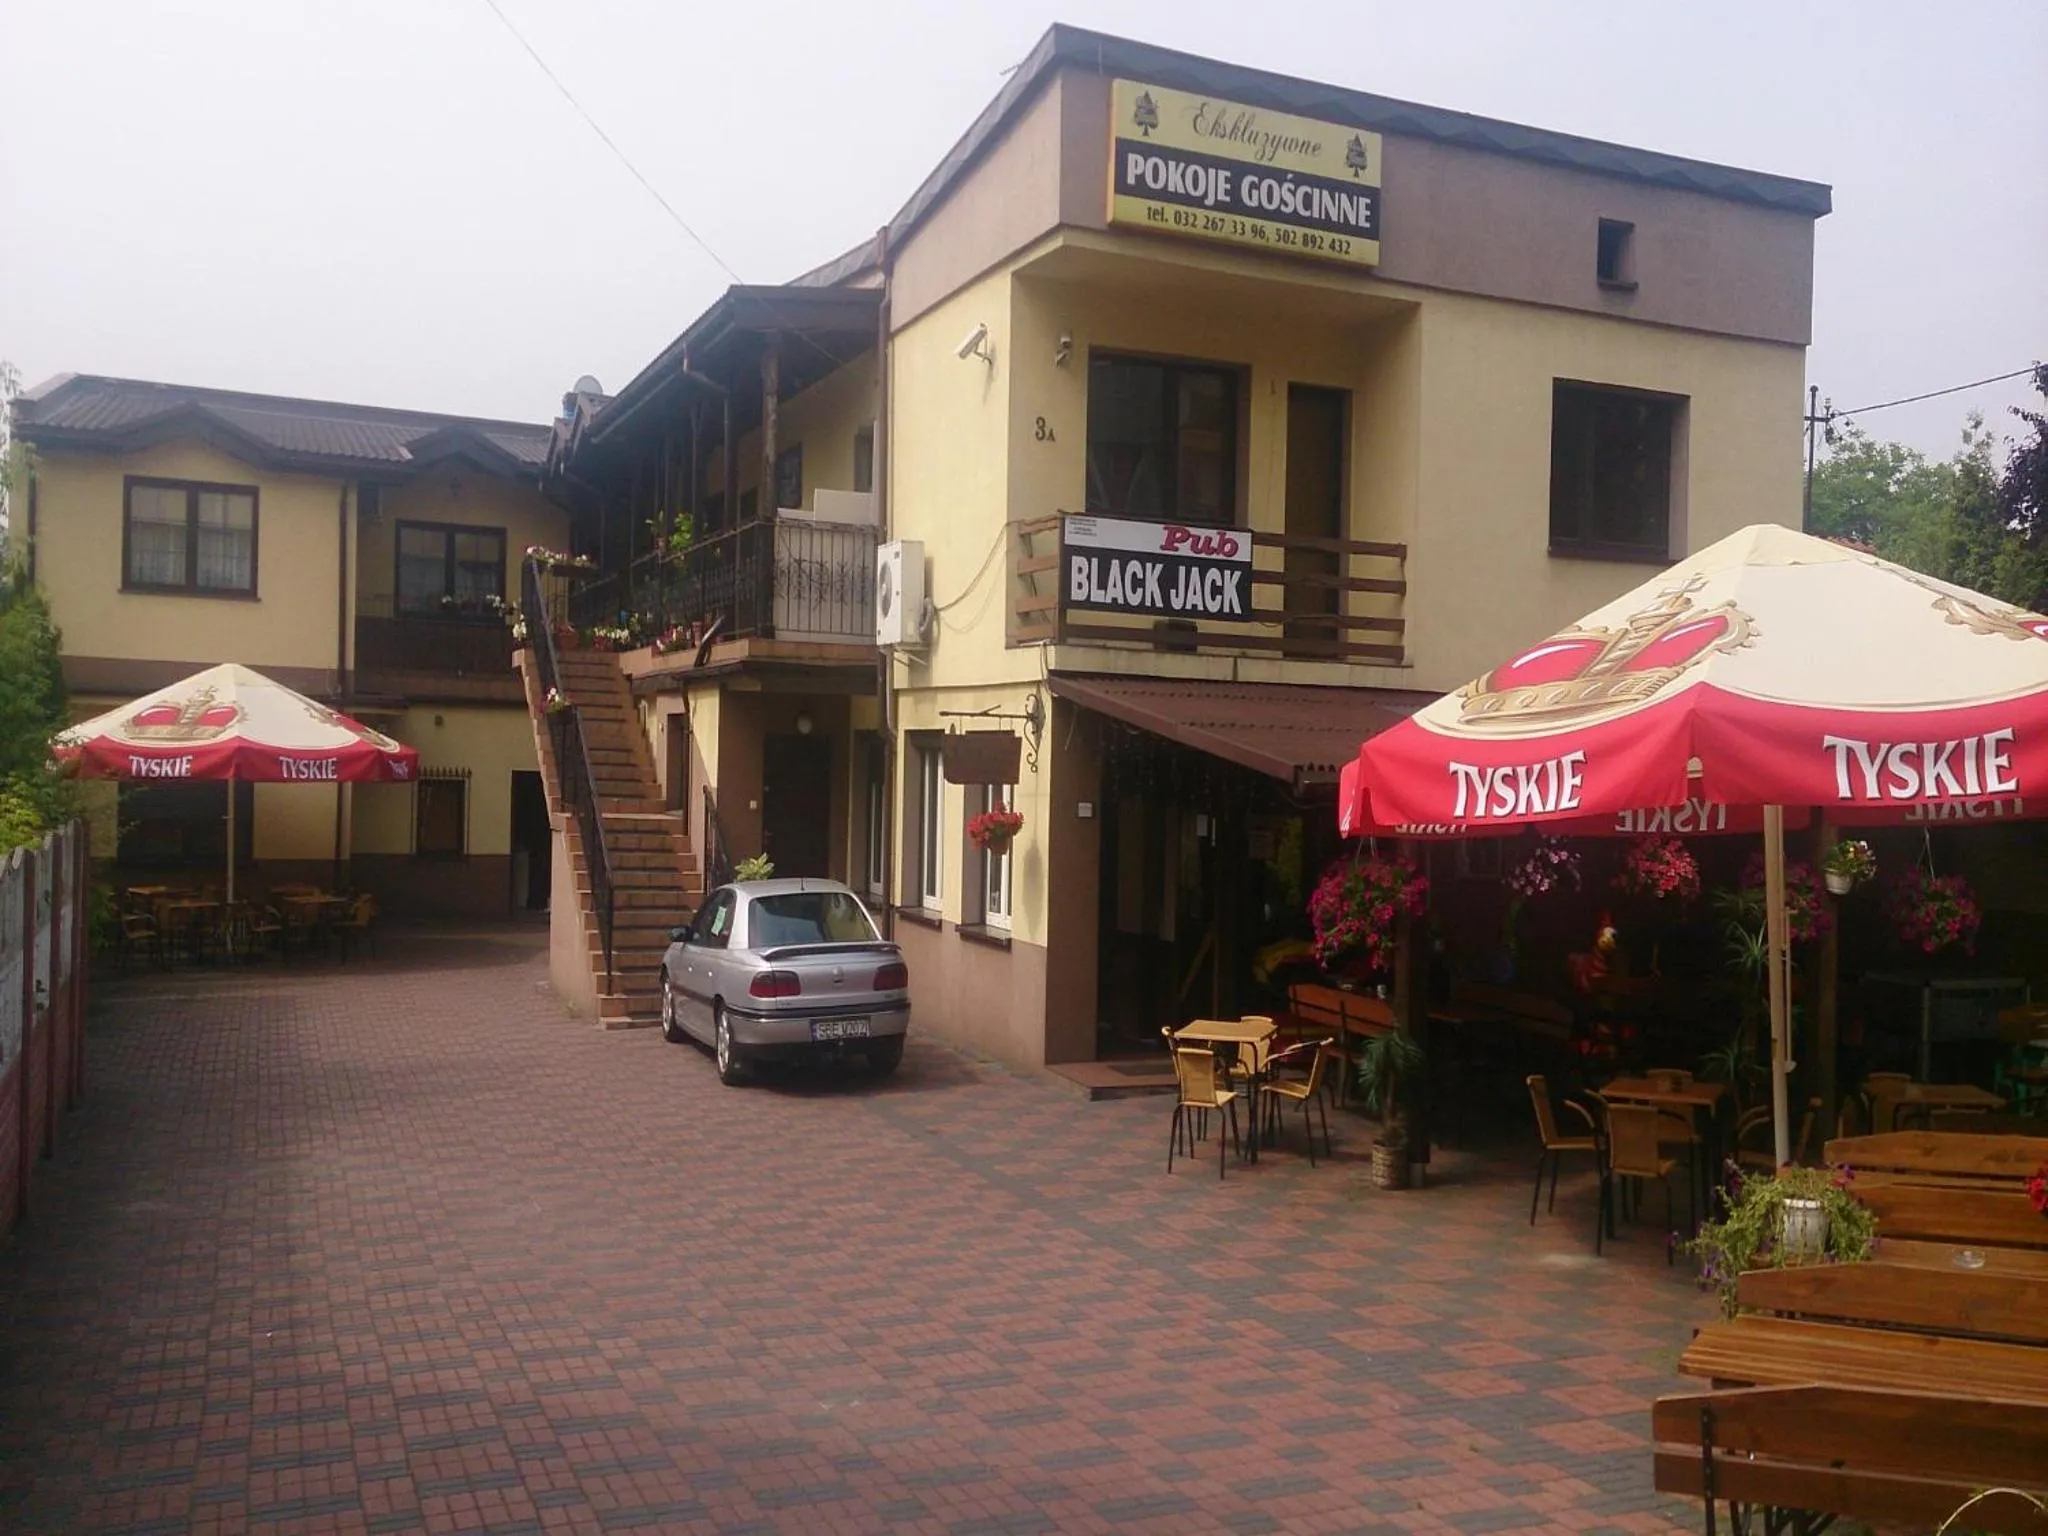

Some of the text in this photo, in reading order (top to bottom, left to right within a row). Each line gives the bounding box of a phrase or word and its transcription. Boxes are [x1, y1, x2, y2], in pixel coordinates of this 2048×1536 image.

[1181, 101, 1322, 162] Ekskluzywne
[1126, 152, 1371, 228] POKOJE GOŚCINNE
[1146, 206, 1351, 255] tel. 032 267 33 96, 502 892 432
[1159, 524, 1239, 558] Pub
[1070, 555, 1243, 615] BLACK JACK
[128, 755, 194, 778] TYSKIE
[279, 756, 338, 780] TYSKIE
[1448, 749, 1587, 818] TYSKIE
[1823, 727, 2019, 799] TYSKIE
